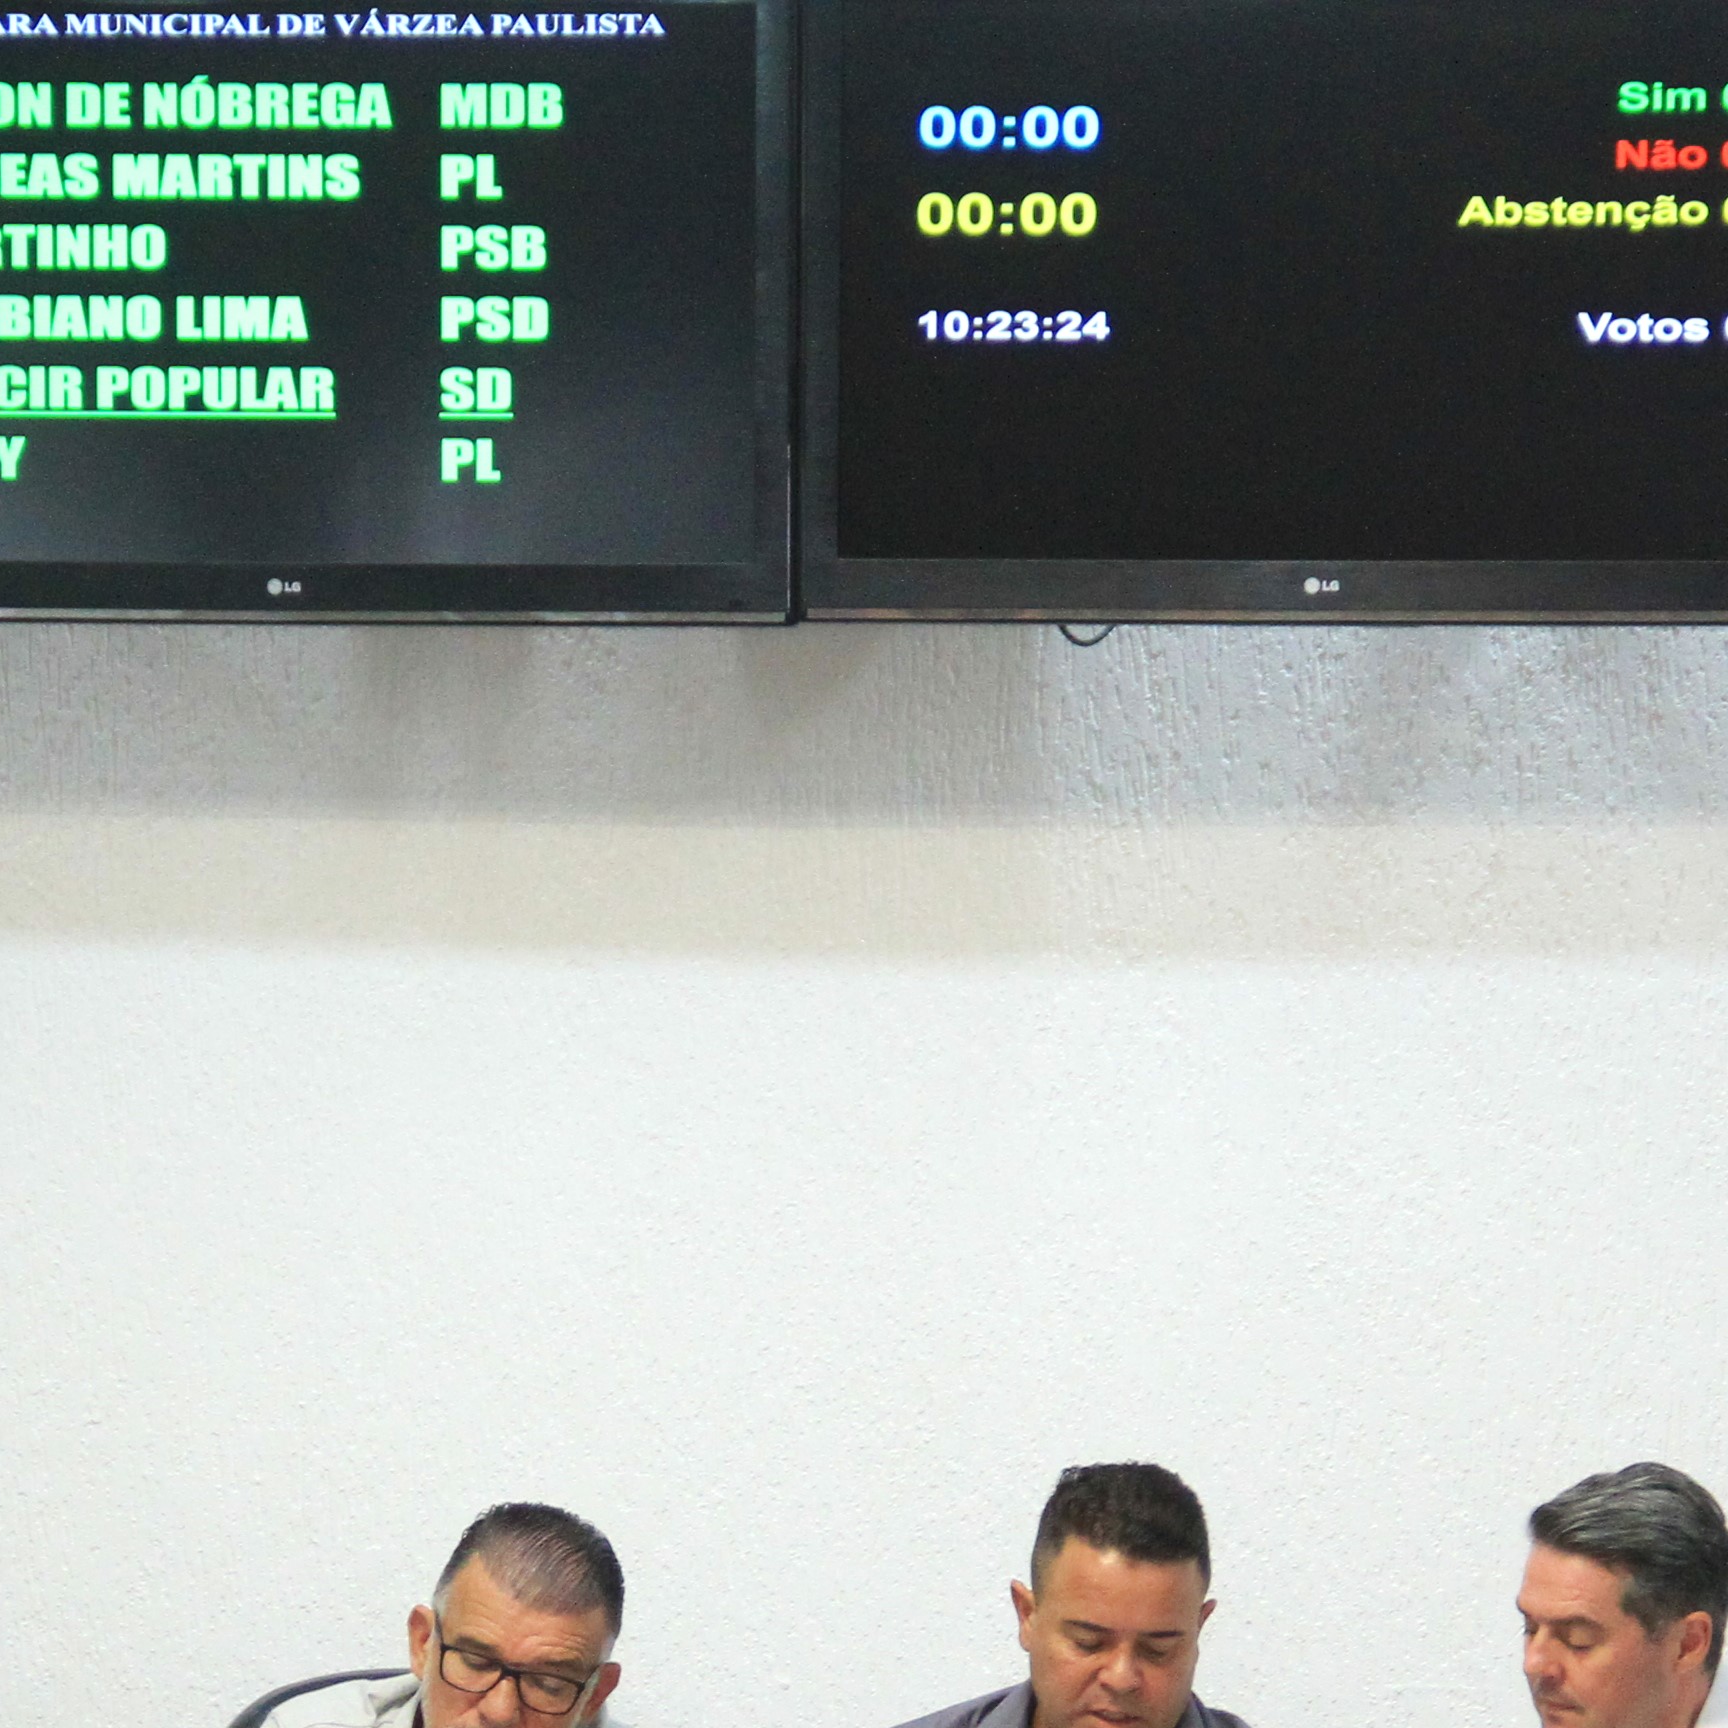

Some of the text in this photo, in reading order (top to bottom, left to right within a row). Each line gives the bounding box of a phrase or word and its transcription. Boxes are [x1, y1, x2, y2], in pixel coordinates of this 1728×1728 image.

[64, 13, 271, 37] MUNICIPAL
[276, 13, 326, 37] DE
[333, 7, 485, 37] VÁRZEA
[490, 12, 666, 37] PAULISTA
[65, 81, 132, 130] DE
[143, 74, 393, 130] NÓBREGA
[439, 82, 564, 130] MDB
[1617, 81, 1707, 114] Sim
[916, 105, 1102, 152] 00:00
[112, 153, 361, 202] MARTINS
[439, 153, 503, 201] PL
[1615, 139, 1709, 171] Não
[916, 191, 1097, 237] 00:00
[1457, 194, 1709, 232] Abstenção
[440, 224, 548, 273] PSB
[175, 295, 309, 343] LIMA
[440, 295, 550, 344] PSD
[918, 309, 1111, 342] 10:23:24
[1577, 311, 1710, 344] Votos
[96, 365, 335, 410] POPULAR
[439, 366, 513, 412] SD
[440, 437, 502, 484] PL
